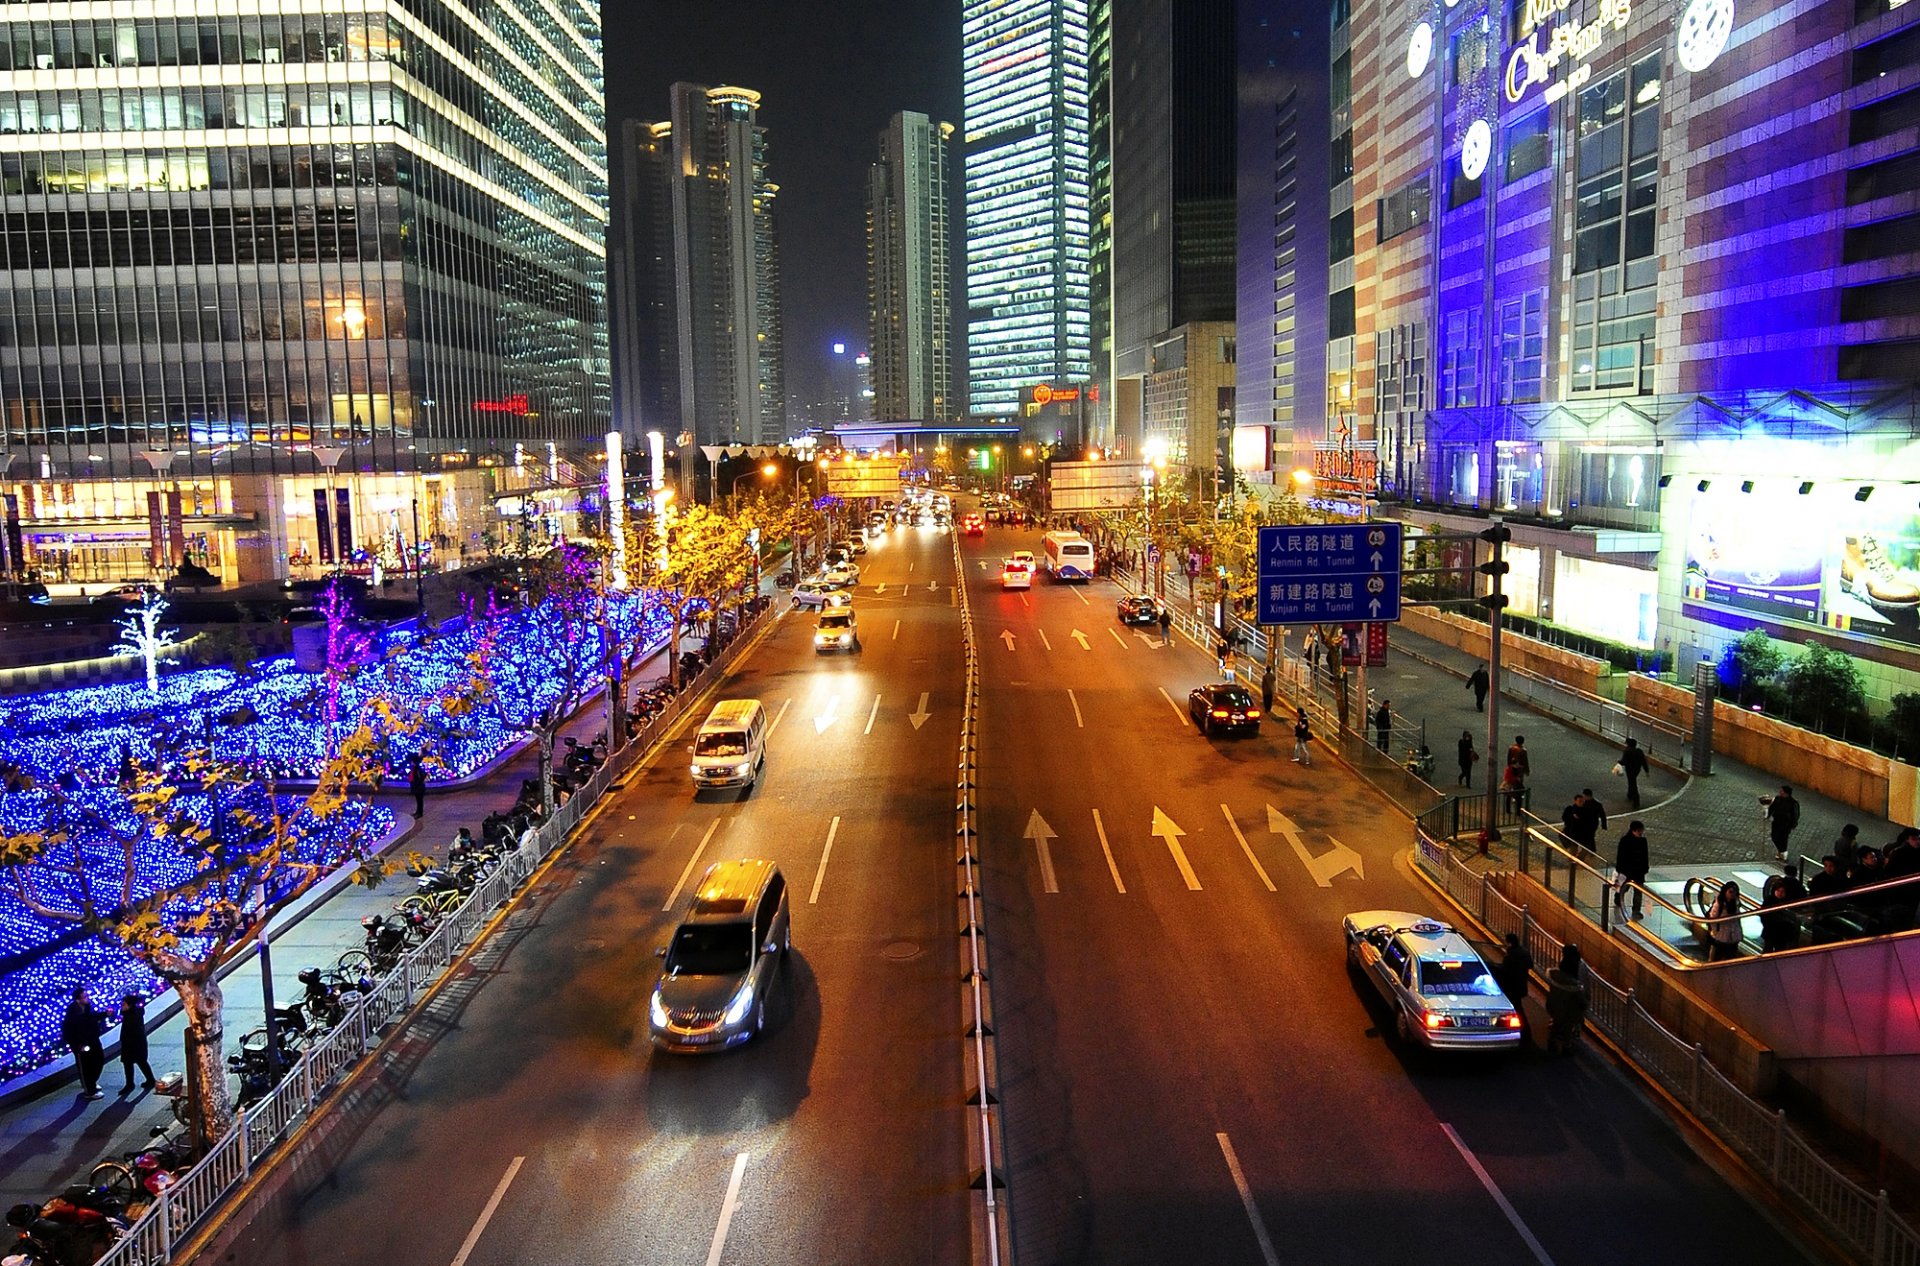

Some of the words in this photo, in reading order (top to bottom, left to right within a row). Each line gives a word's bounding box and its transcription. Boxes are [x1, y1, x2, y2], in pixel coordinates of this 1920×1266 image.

[1271, 534, 1354, 552] 人民路隧道
[1270, 557, 1302, 567] Renmin
[1307, 556, 1321, 567] Rd.
[1327, 555, 1355, 566] Tunnel
[1270, 583, 1353, 601] 新建路隧道
[1270, 603, 1298, 615] Xinjian
[1326, 601, 1353, 612] Tunnel
